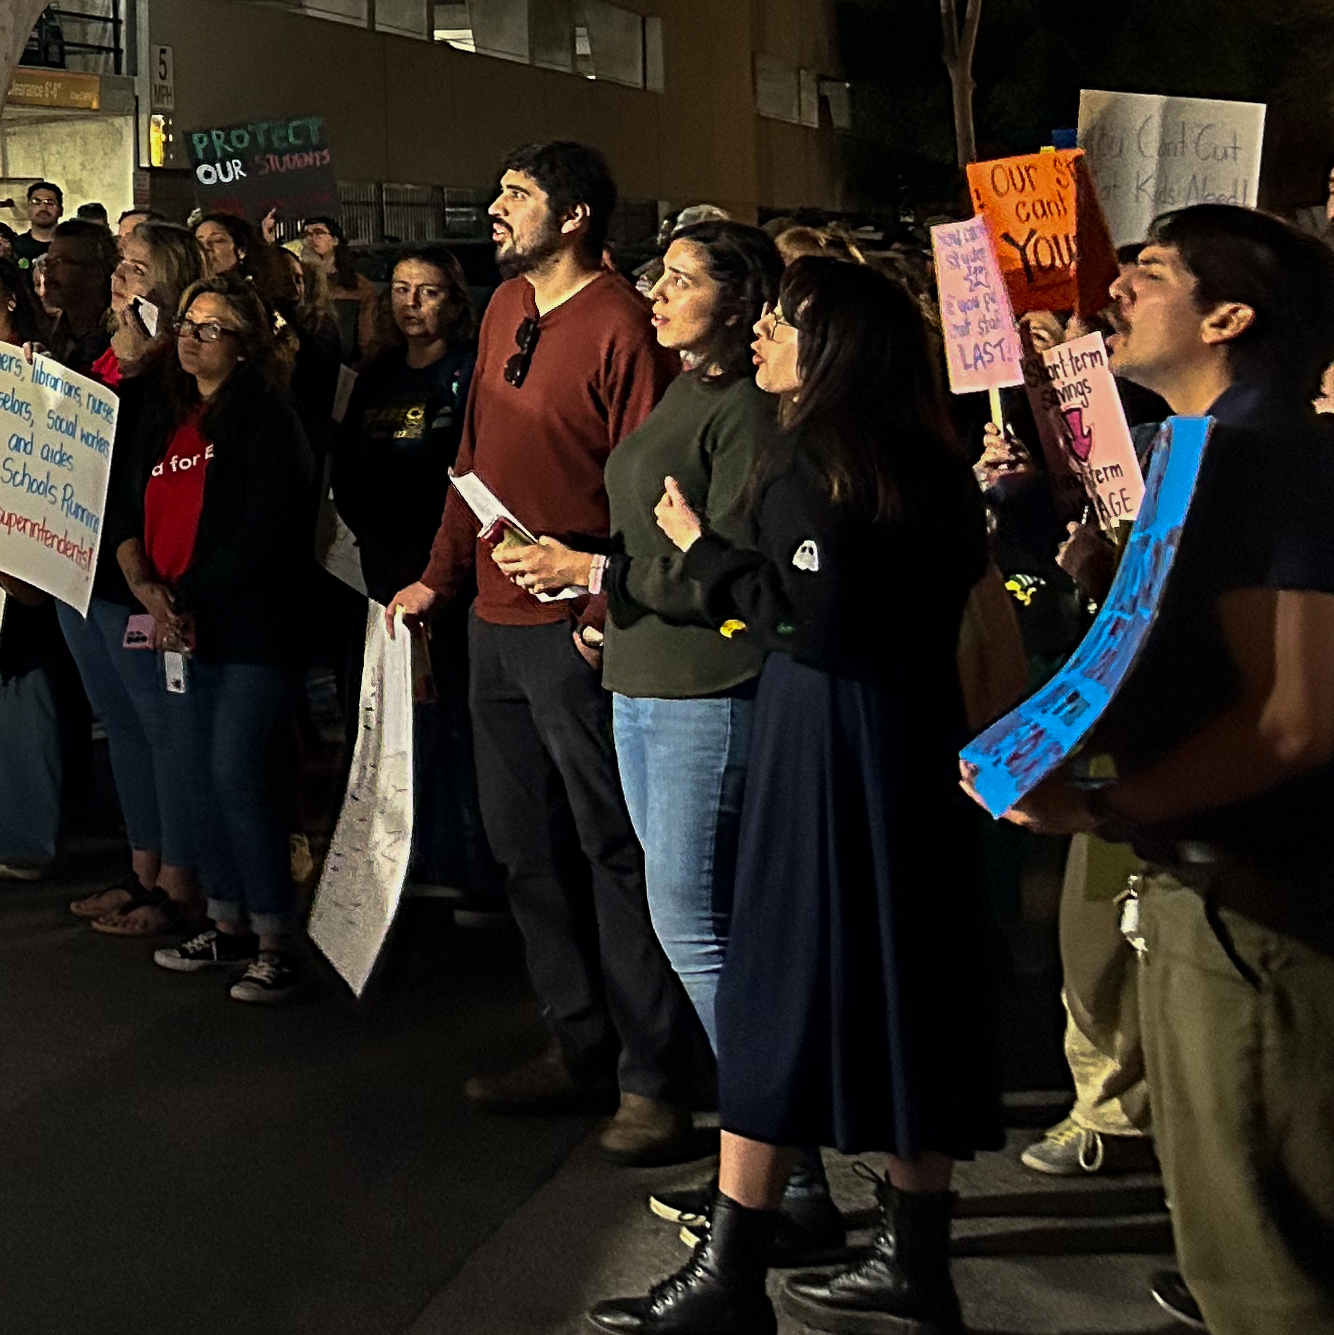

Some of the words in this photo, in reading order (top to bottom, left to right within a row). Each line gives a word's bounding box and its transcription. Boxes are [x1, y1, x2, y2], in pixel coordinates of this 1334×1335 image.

[158, 48, 168, 81] 5
[192, 117, 323, 158] PROTECT
[1195, 123, 1243, 162] Cut
[196, 158, 248, 186] OUR
[254, 148, 331, 176] STUDENTS
[957, 337, 1014, 371] LAST!
[31, 363, 84, 409] librarians,
[8, 433, 33, 457] and
[41, 443, 75, 471] aides
[81, 425, 110, 460] workers
[0, 456, 58, 506] Schools
[170, 454, 201, 473] for
